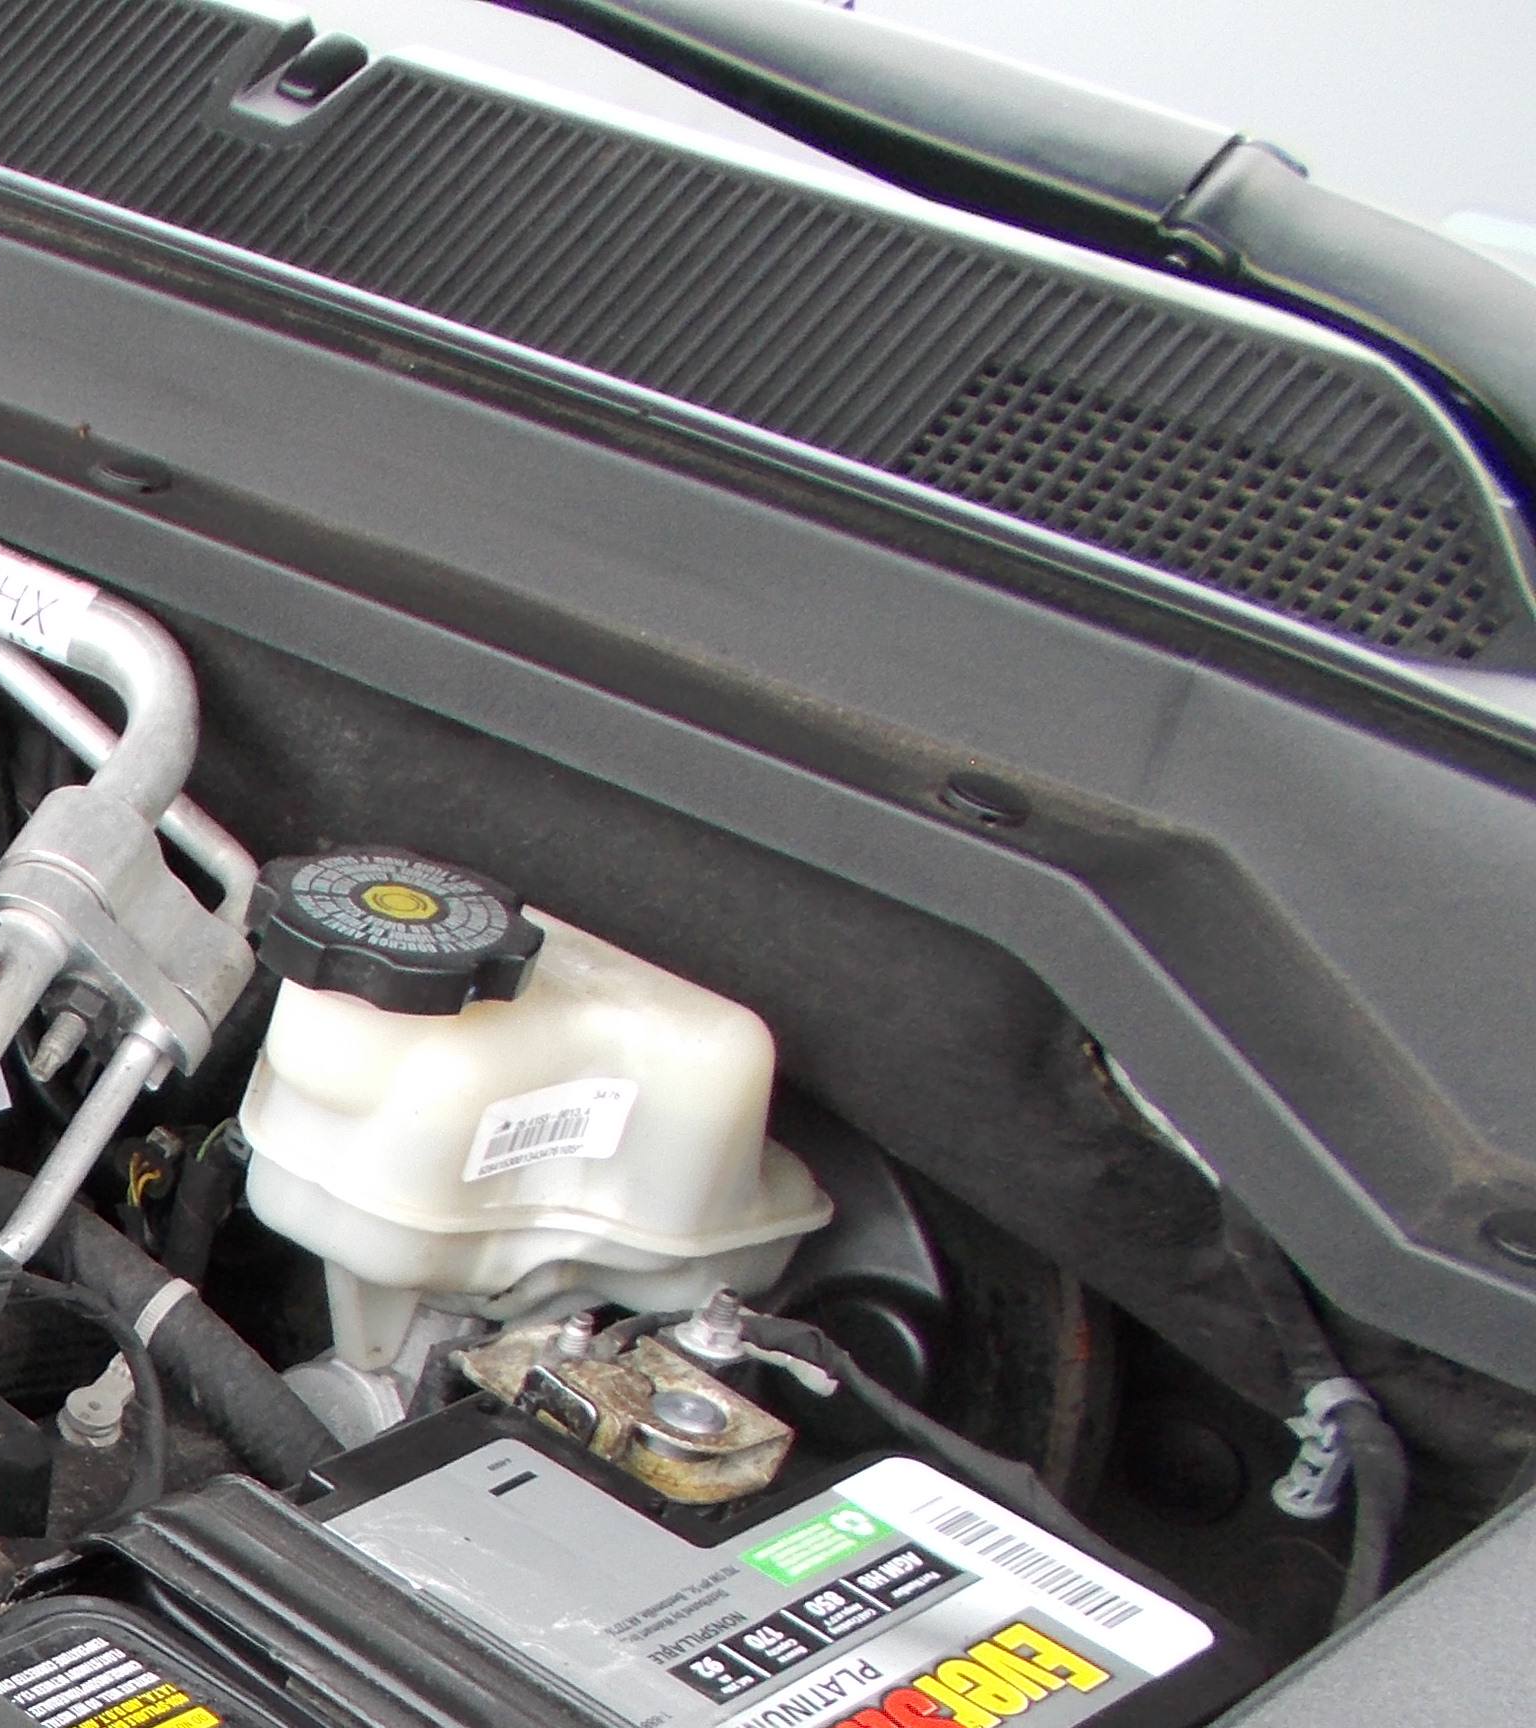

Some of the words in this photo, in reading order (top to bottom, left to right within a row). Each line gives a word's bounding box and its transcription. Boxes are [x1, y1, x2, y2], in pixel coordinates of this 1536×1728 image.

[877, 1551, 923, 1578] AGM
[802, 1590, 847, 1616] 850
[646, 1609, 748, 1665] NONSPILLABLE
[741, 1624, 785, 1650] 170
[688, 1656, 726, 1678] 92
